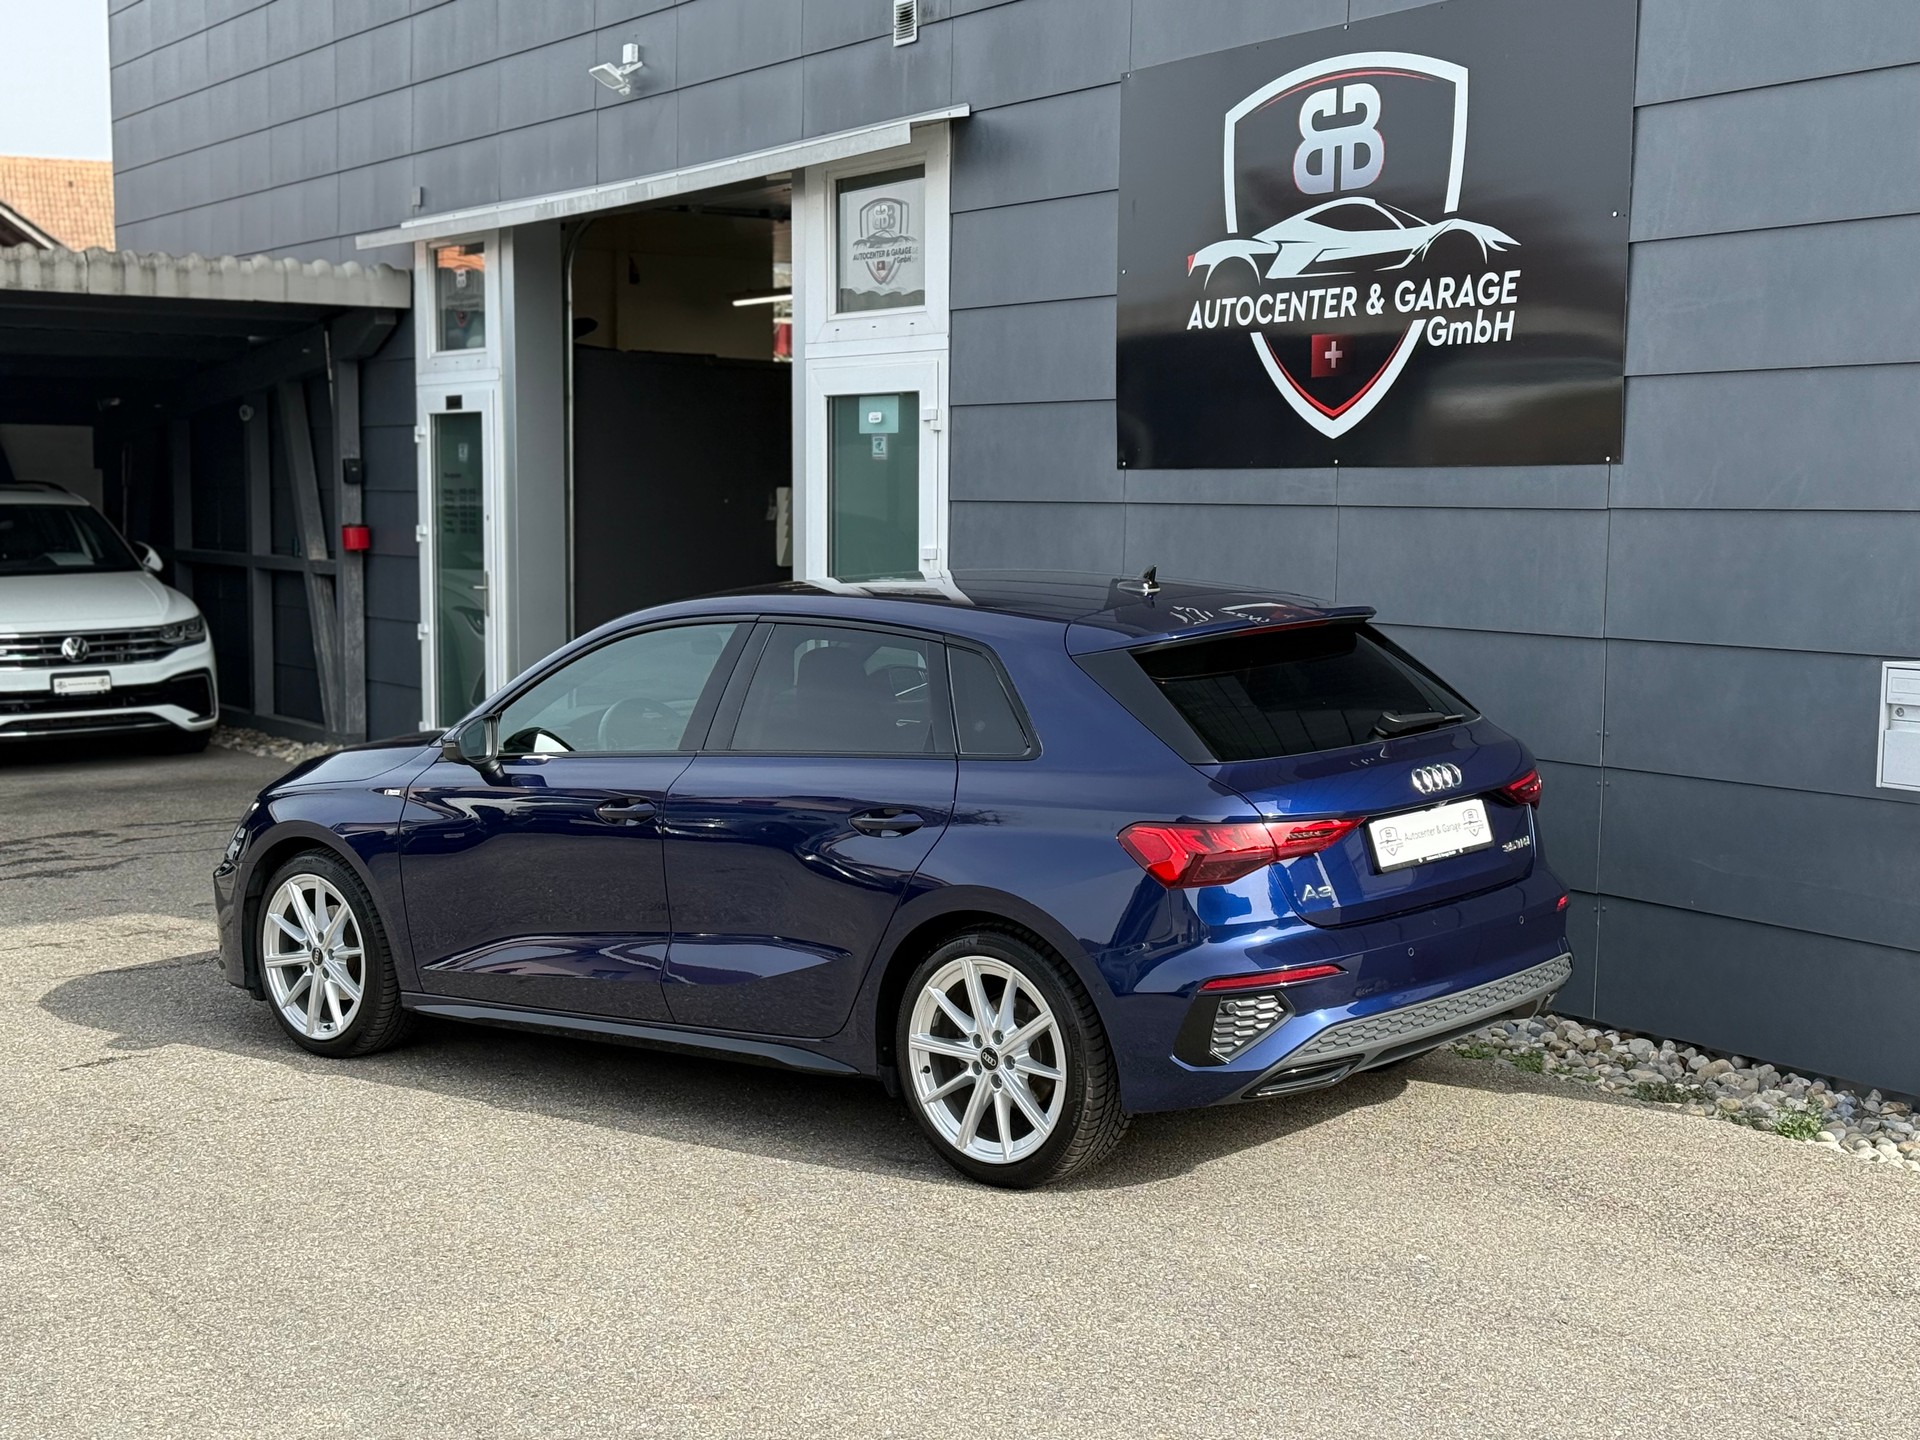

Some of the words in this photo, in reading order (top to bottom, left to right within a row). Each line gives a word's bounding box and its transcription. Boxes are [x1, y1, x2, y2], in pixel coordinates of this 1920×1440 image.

[1186, 286, 1357, 331] AUTOCENTER
[1366, 283, 1385, 316] &
[1393, 269, 1521, 313] GARAGE
[1426, 308, 1516, 347] GmbH
[1404, 828, 1436, 842] Autocenter
[1442, 822, 1462, 834] Garage
[1302, 884, 1332, 902] A3
